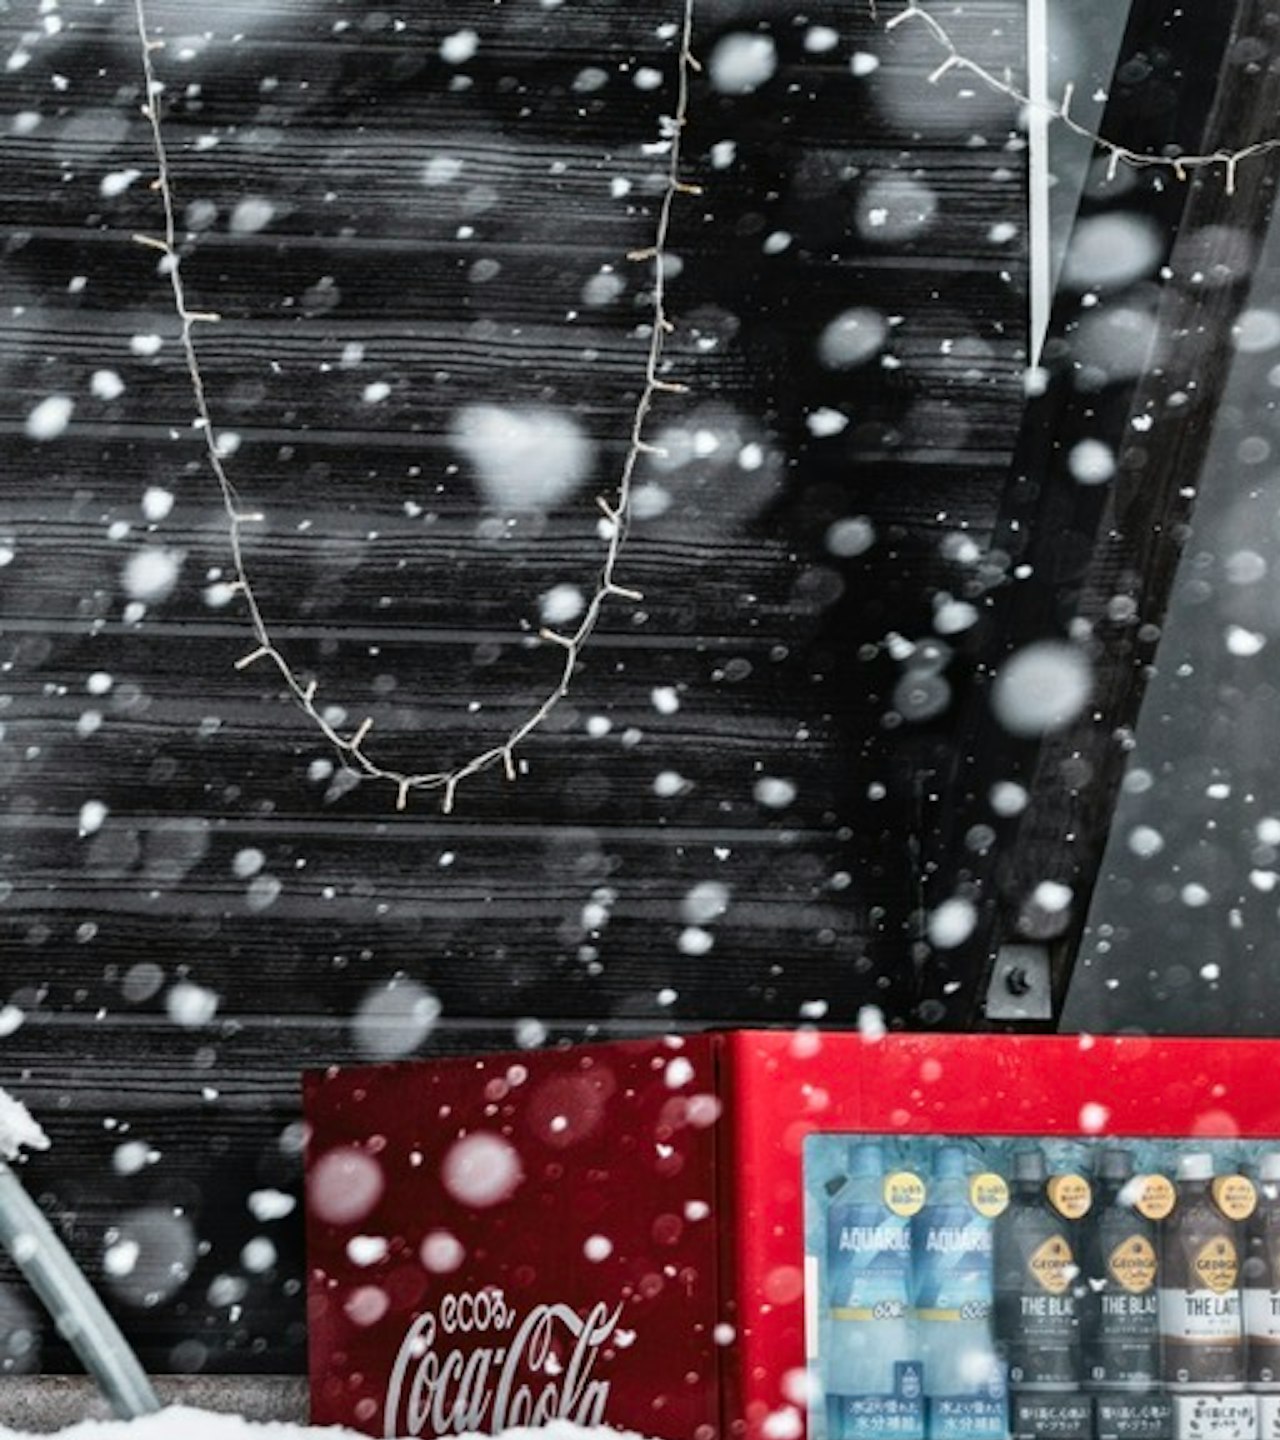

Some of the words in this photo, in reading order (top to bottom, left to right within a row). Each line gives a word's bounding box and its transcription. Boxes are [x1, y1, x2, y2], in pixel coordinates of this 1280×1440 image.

[1020, 1296, 1046, 1316] THE
[1101, 1295, 1127, 1315] THE
[1185, 1297, 1211, 1316] THE
